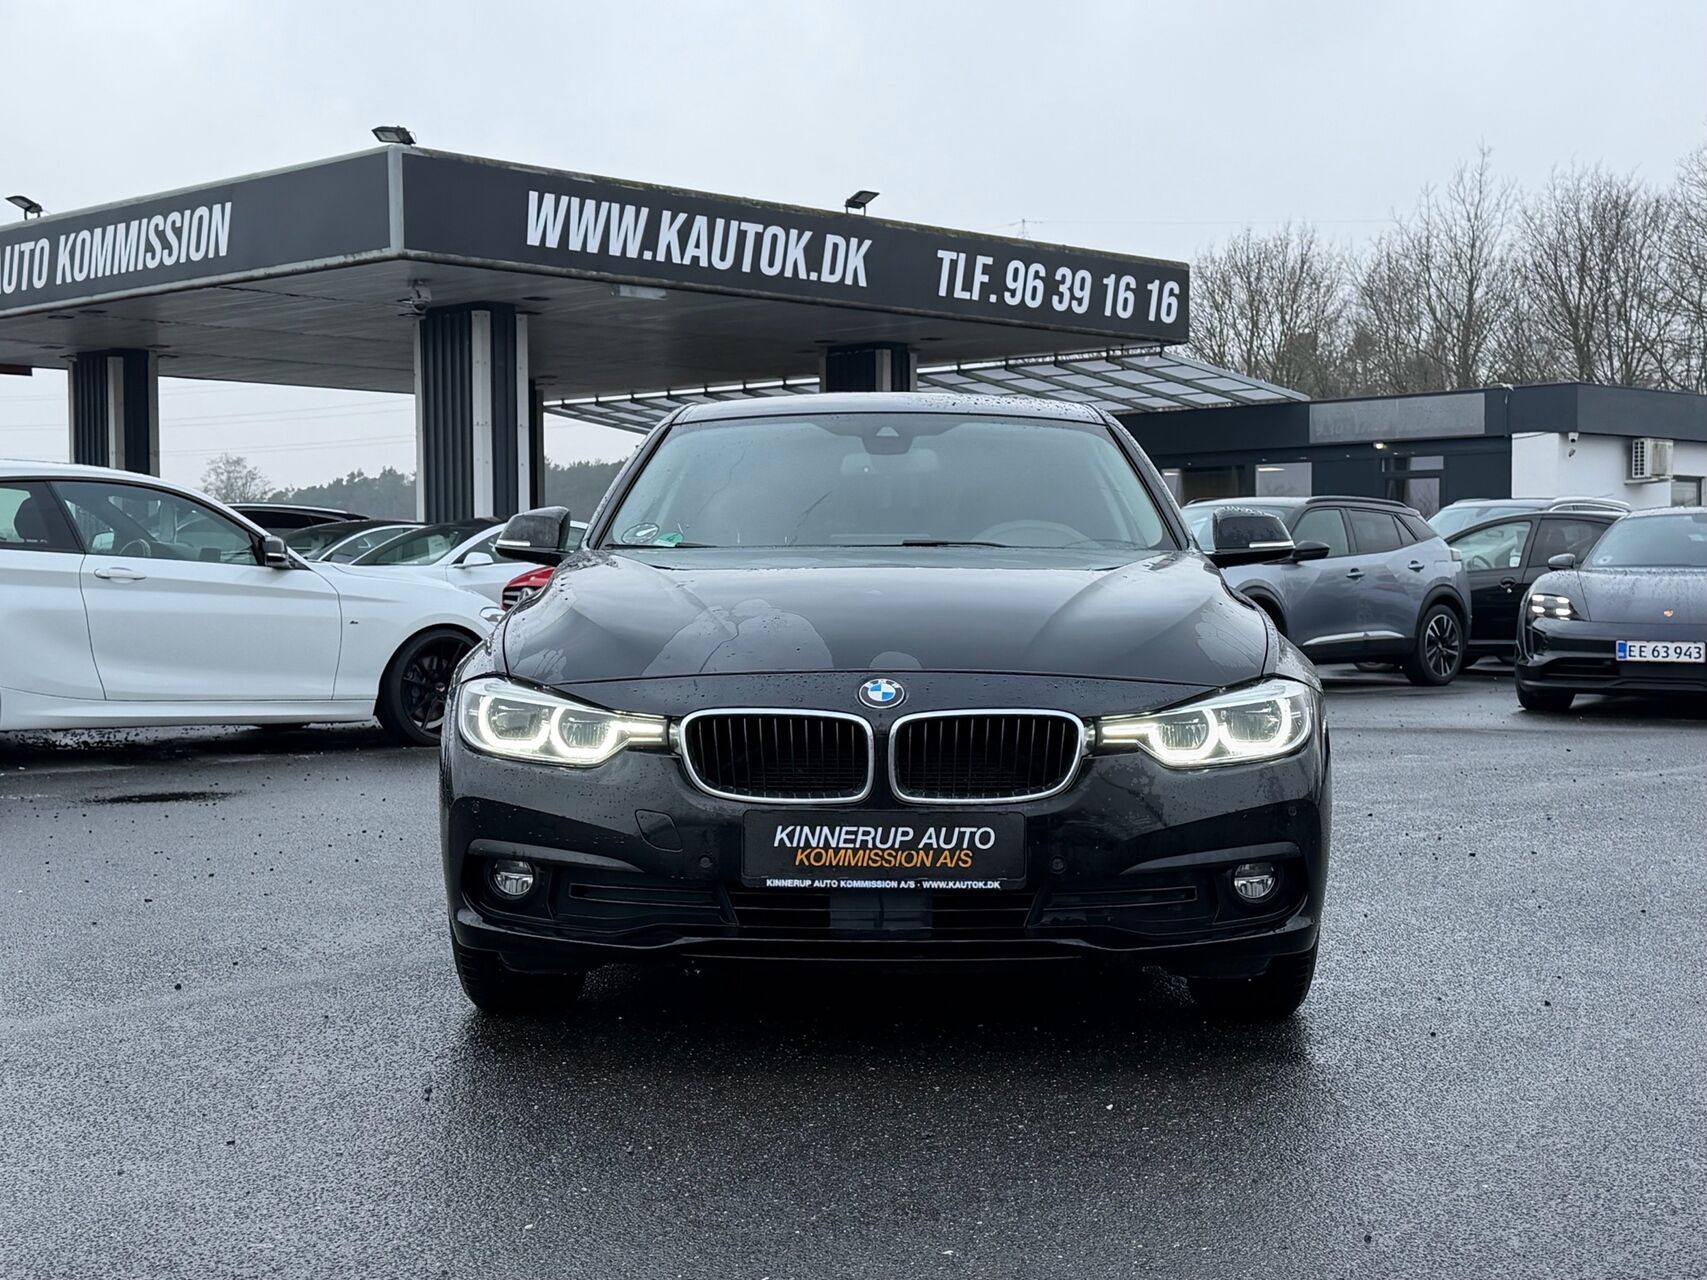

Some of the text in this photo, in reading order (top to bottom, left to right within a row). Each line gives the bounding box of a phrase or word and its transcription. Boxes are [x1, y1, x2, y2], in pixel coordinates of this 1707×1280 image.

[0, 201, 232, 295] UTO KOMMISSION
[526, 190, 873, 288] WWW.KAUTOK.DK
[936, 249, 1180, 324] TLF. 96 39 16 16
[1628, 645, 1647, 658] EE
[1651, 645, 1670, 658] 63
[1674, 646, 1702, 660] 943
[773, 825, 996, 850] KINNERUP AUTO
[795, 848, 973, 868] KOMMISSION A/S
[766, 878, 1001, 890] KINNERUP AUTO KOMMISSION A/S WWW.KAUTOK.DK
